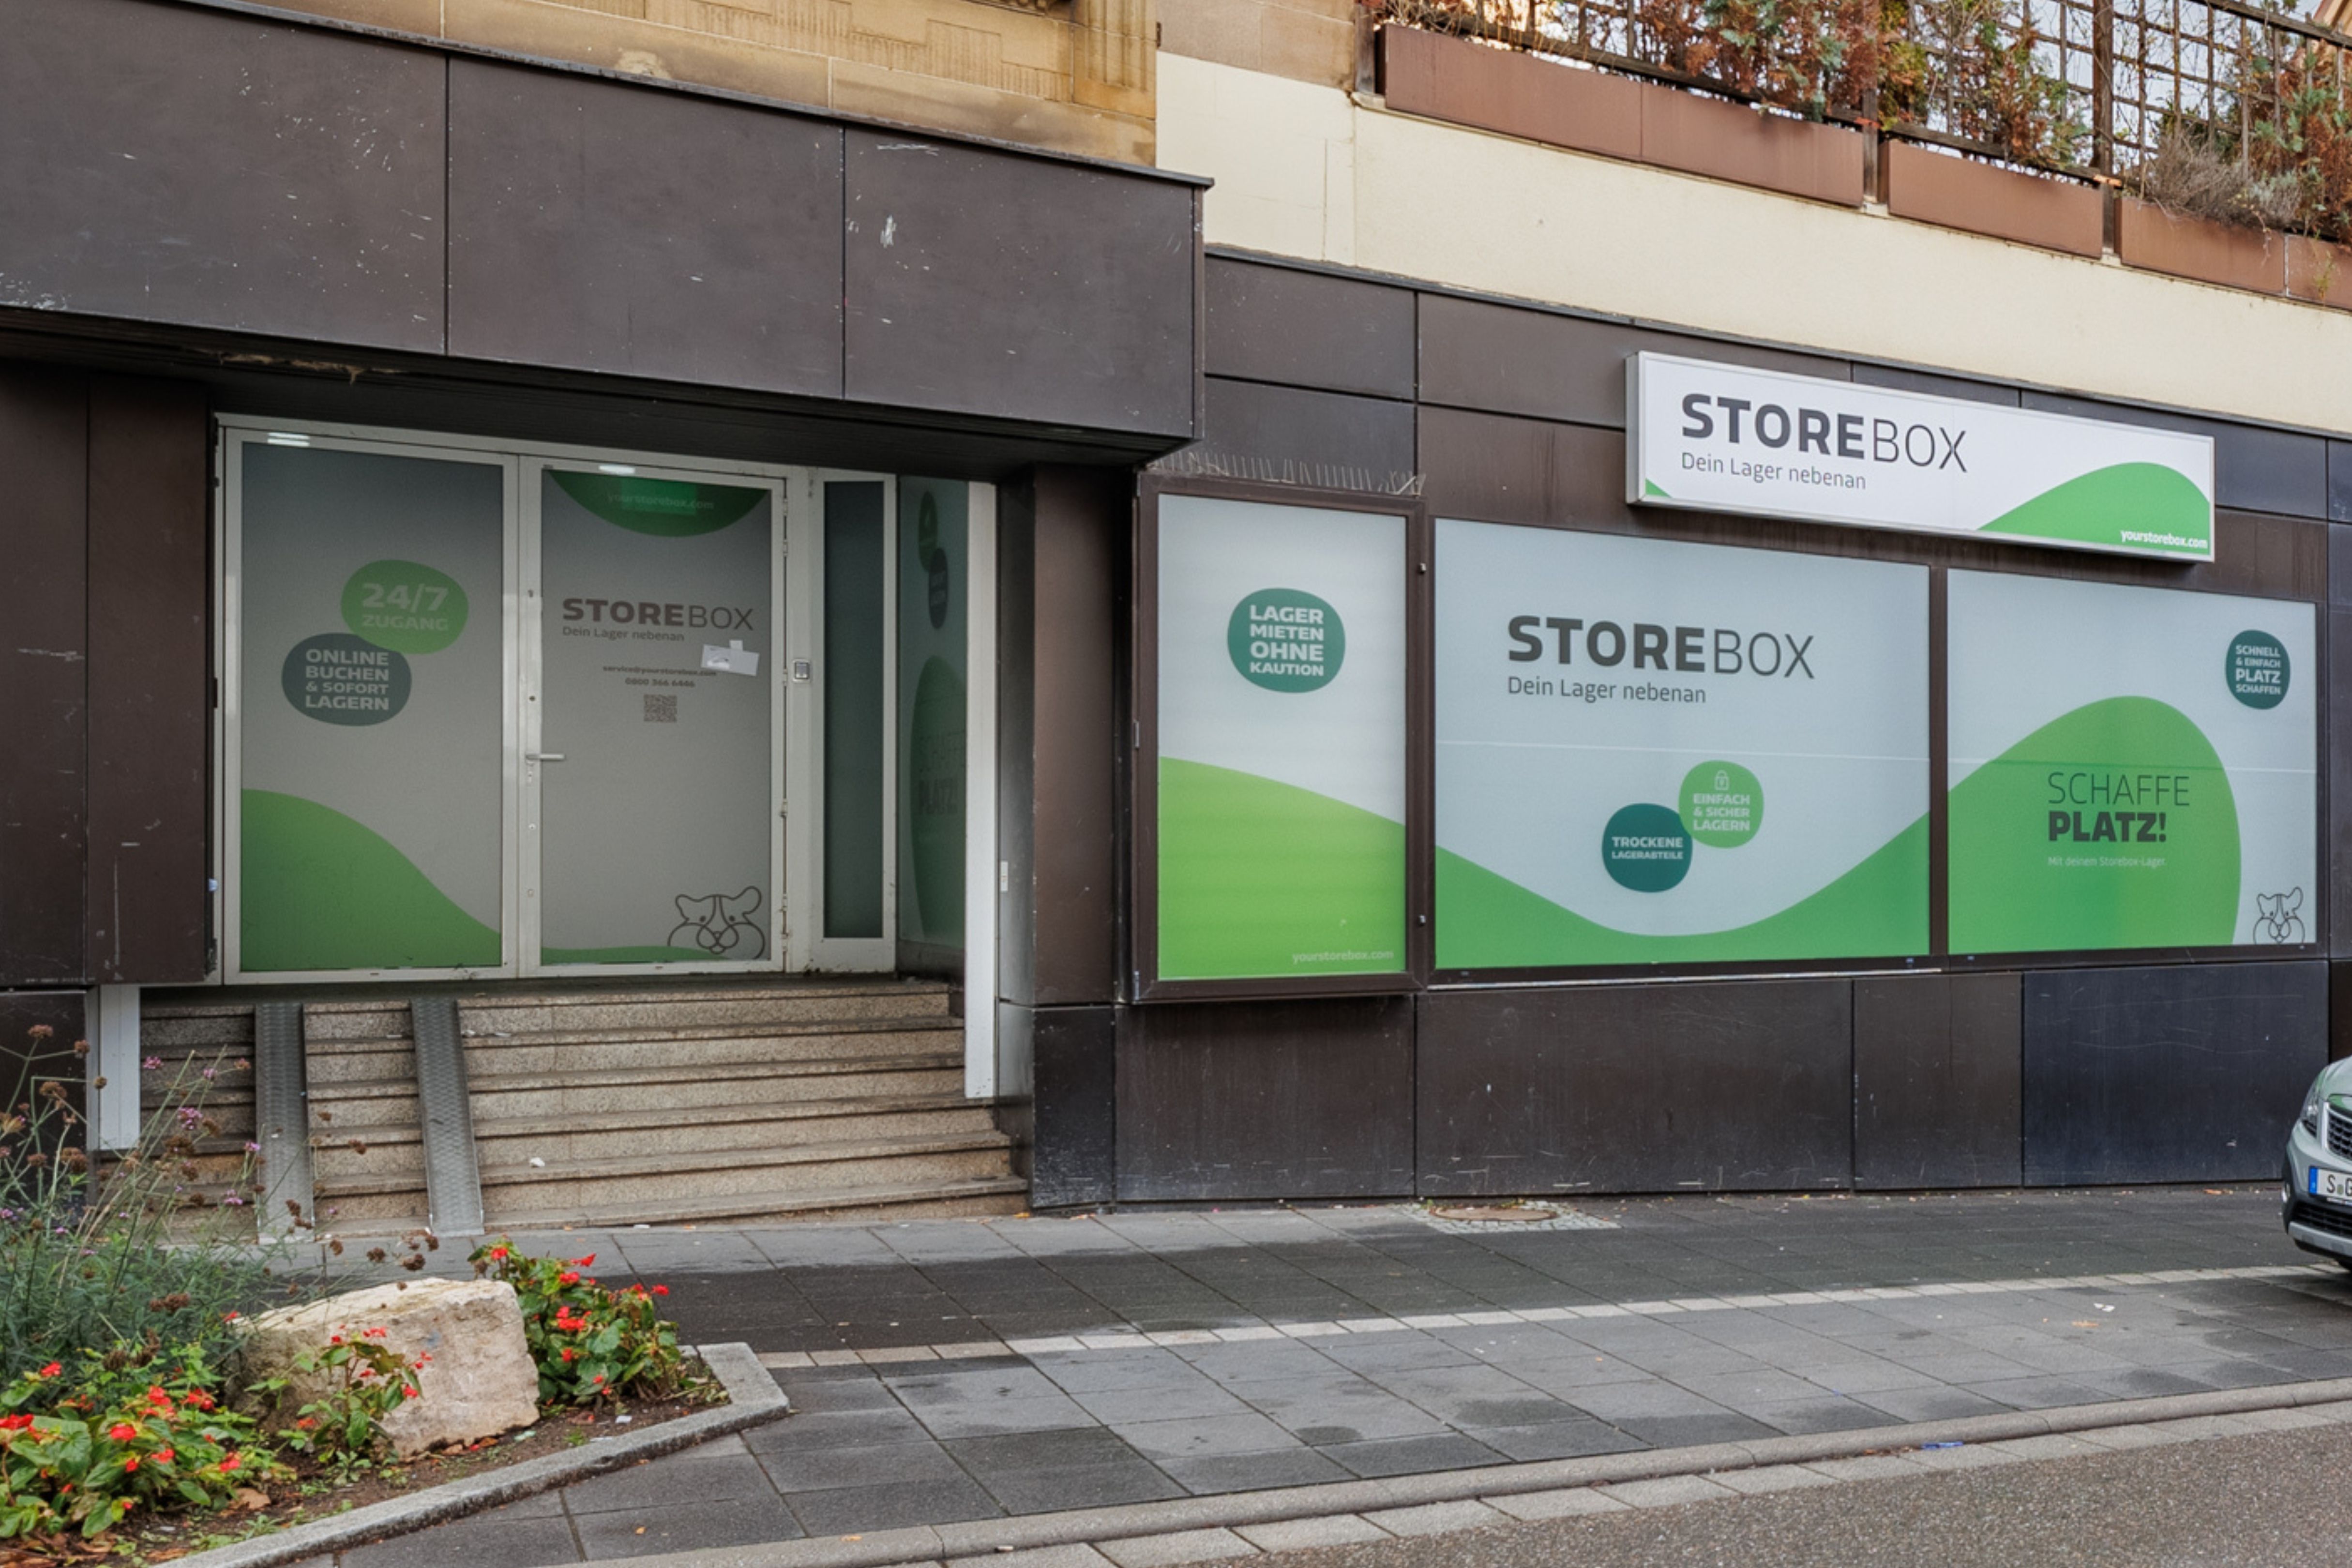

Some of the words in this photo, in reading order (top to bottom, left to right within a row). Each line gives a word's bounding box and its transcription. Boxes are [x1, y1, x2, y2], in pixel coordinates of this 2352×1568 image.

[1682, 393, 1967, 473] STOREBOX
[1682, 452, 1723, 474] Dein
[1731, 457, 1782, 483] Lager
[1789, 467, 1866, 490] nebenan
[607, 494, 714, 509] yourstorebox.com
[2121, 529, 2207, 549] yourstorebox.com
[362, 583, 448, 613] 24/7
[563, 598, 753, 631] STOREBOX
[1250, 604, 1324, 624] LAGER
[362, 615, 448, 631] ZUGANG
[563, 626, 590, 637] Dein
[594, 629, 628, 639] Lager
[632, 630, 684, 641] nebenan
[1250, 624, 1324, 641] MIETEN
[1250, 641, 1324, 661] OHNE
[1508, 615, 1814, 679] STOREBOX
[2236, 645, 2280, 657] SCHNELL
[305, 648, 389, 665] ONLINE
[2236, 657, 2242, 666] &
[2244, 658, 2280, 668] EINFACH
[305, 665, 389, 681] BUCHEN
[1250, 662, 1324, 676] KAUTION
[2236, 668, 2280, 683] PLATZ
[305, 682, 317, 693] &
[323, 683, 388, 694] SOFORT
[1508, 676, 1553, 695] Dein
[1561, 679, 1616, 703] Lager
[1623, 683, 1706, 703] nebenan
[2236, 684, 2281, 694] SCHAFFEN
[305, 694, 389, 710] LAGERN
[2048, 772, 2189, 806] SCHAFFE
[1693, 793, 1750, 805] EINFACH
[1694, 807, 1702, 816] &
[1706, 807, 1750, 817] SICHER
[1693, 820, 1750, 831] LAGERN
[2048, 811, 2167, 842] PLATZ!
[1612, 837, 1683, 847] TROCKENE
[1612, 850, 1683, 859] LAGERABTEILE
[2048, 856, 2062, 866] Mit
[2066, 856, 2097, 866] deinem
[1292, 950, 1394, 964] yourstorebox.com
[2327, 1174, 2336, 1193] S
